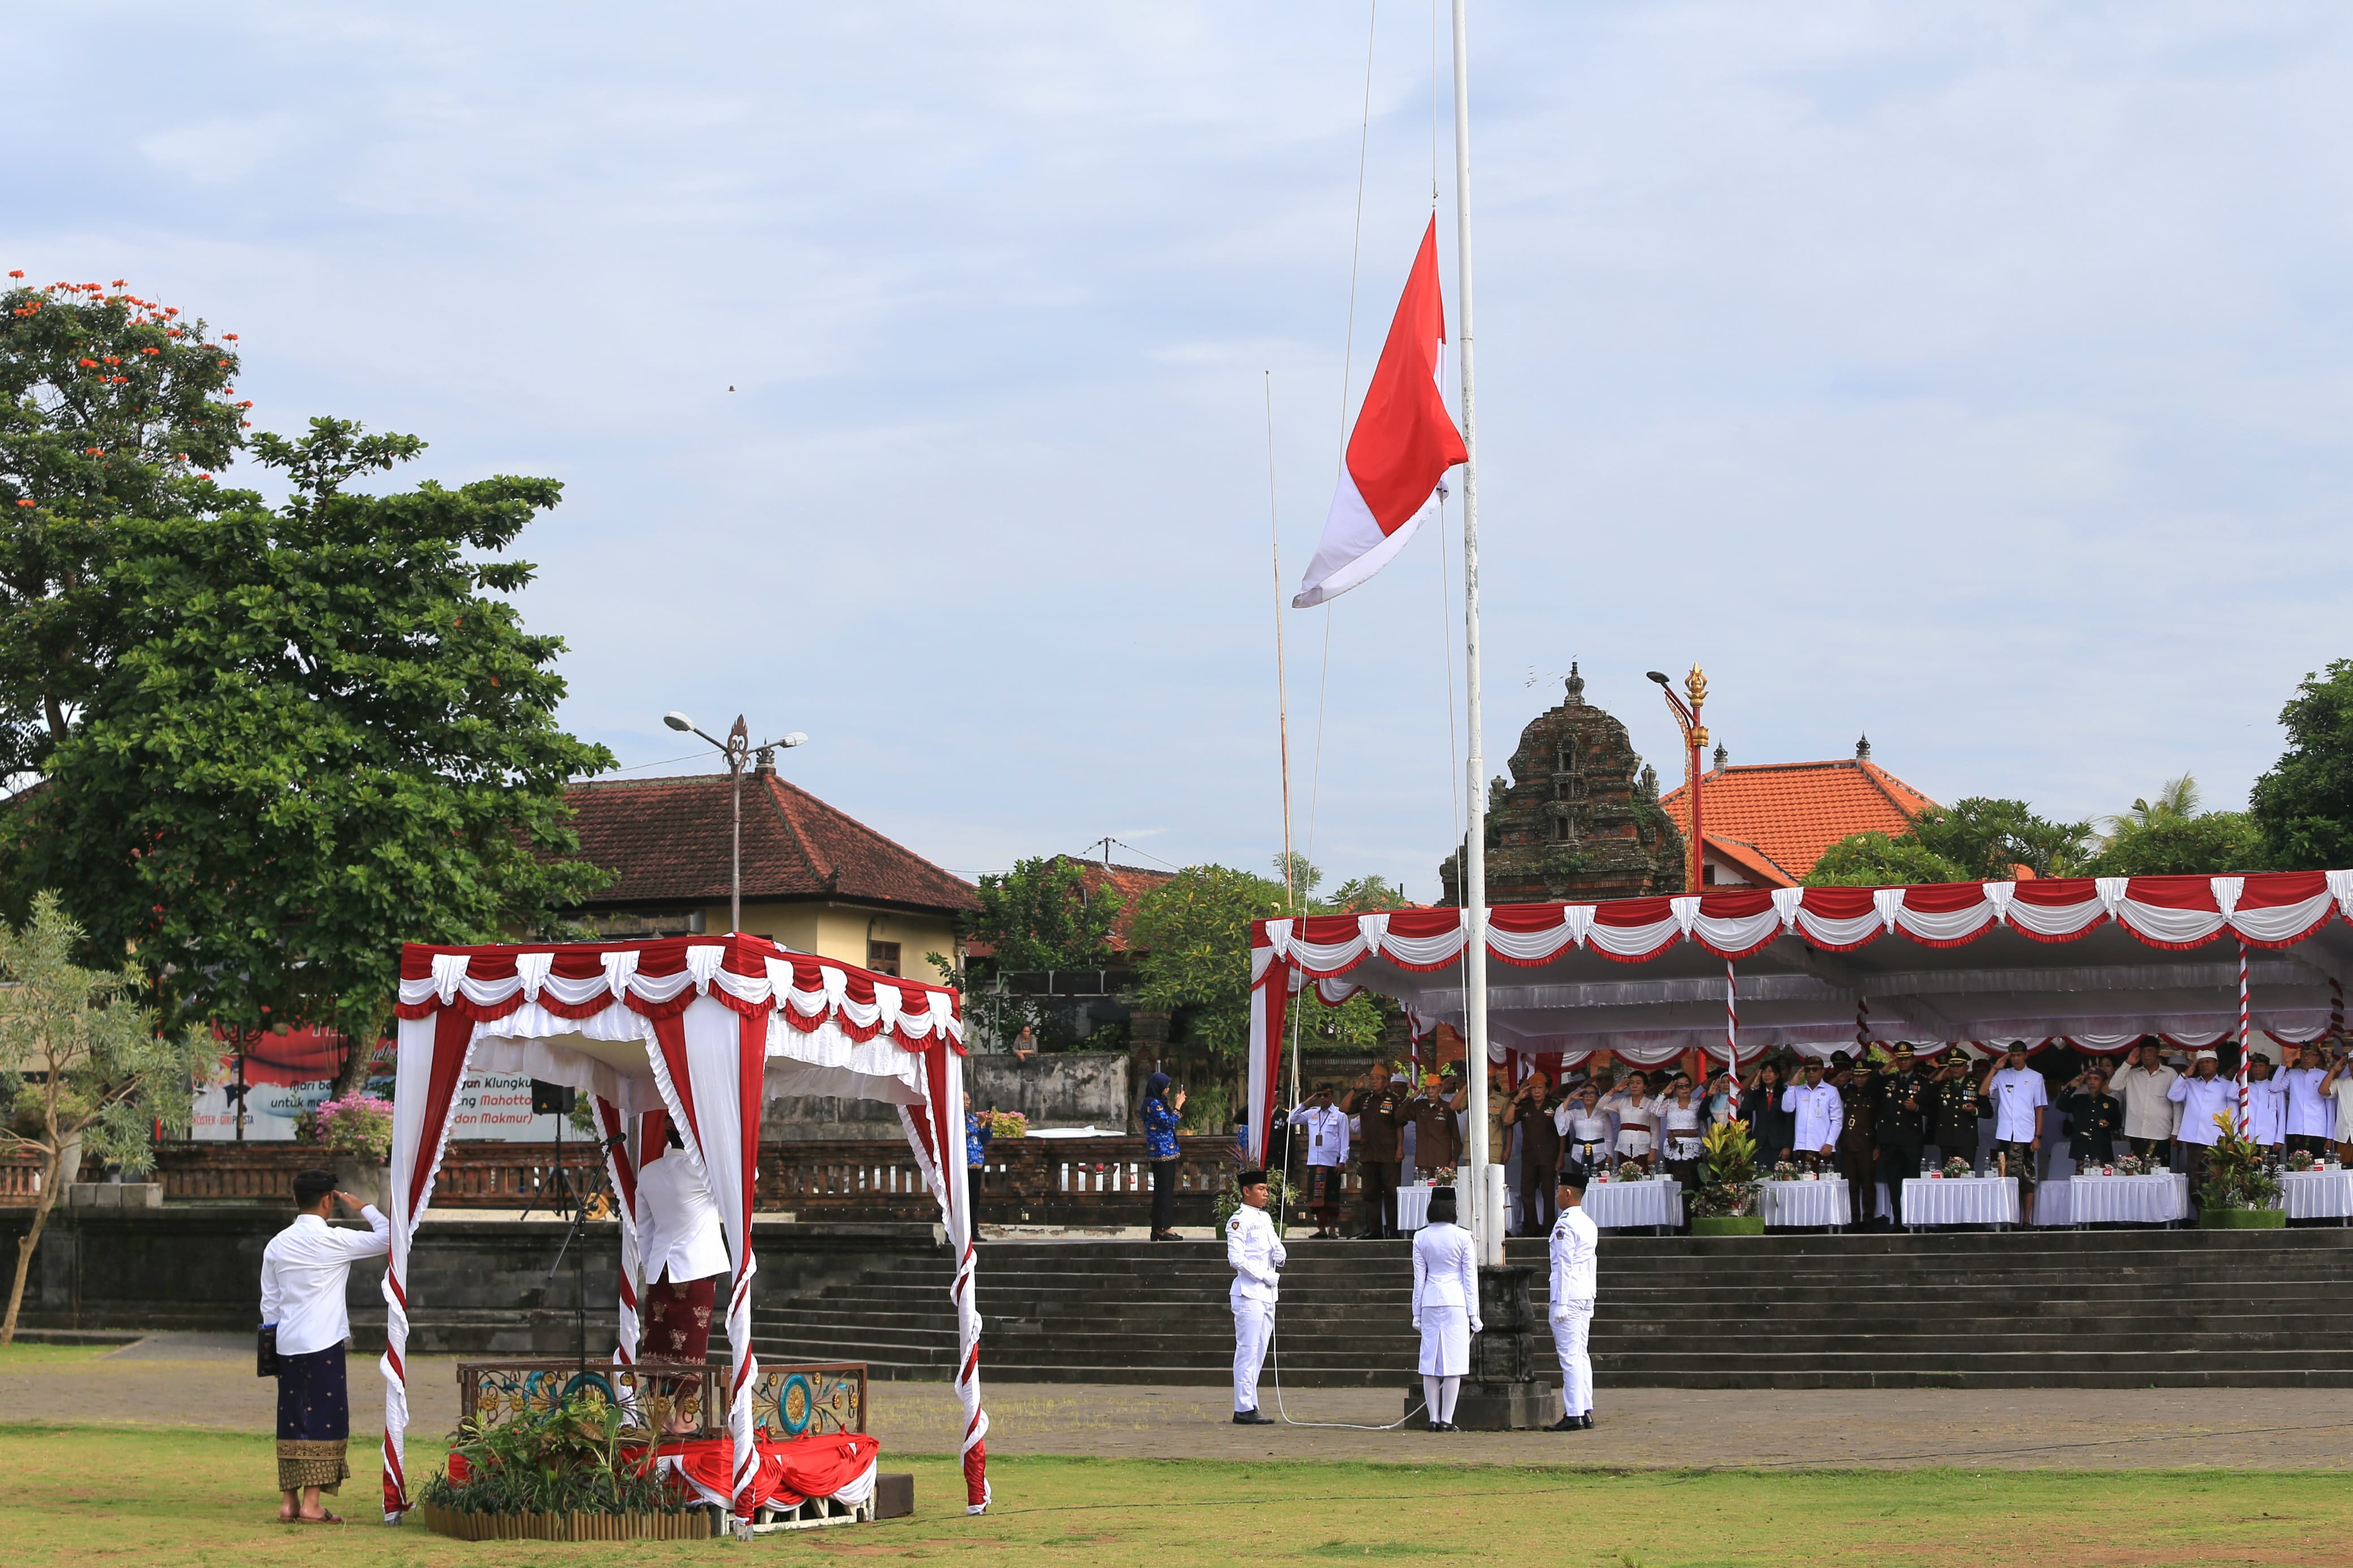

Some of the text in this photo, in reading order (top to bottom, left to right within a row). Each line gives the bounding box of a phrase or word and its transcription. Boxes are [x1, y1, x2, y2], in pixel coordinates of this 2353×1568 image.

[484, 1077, 532, 1091] Klungku
[272, 1096, 304, 1108] untuk
[480, 1095, 533, 1105] Mahotta
[454, 1112, 533, 1125] dan Makmur)
